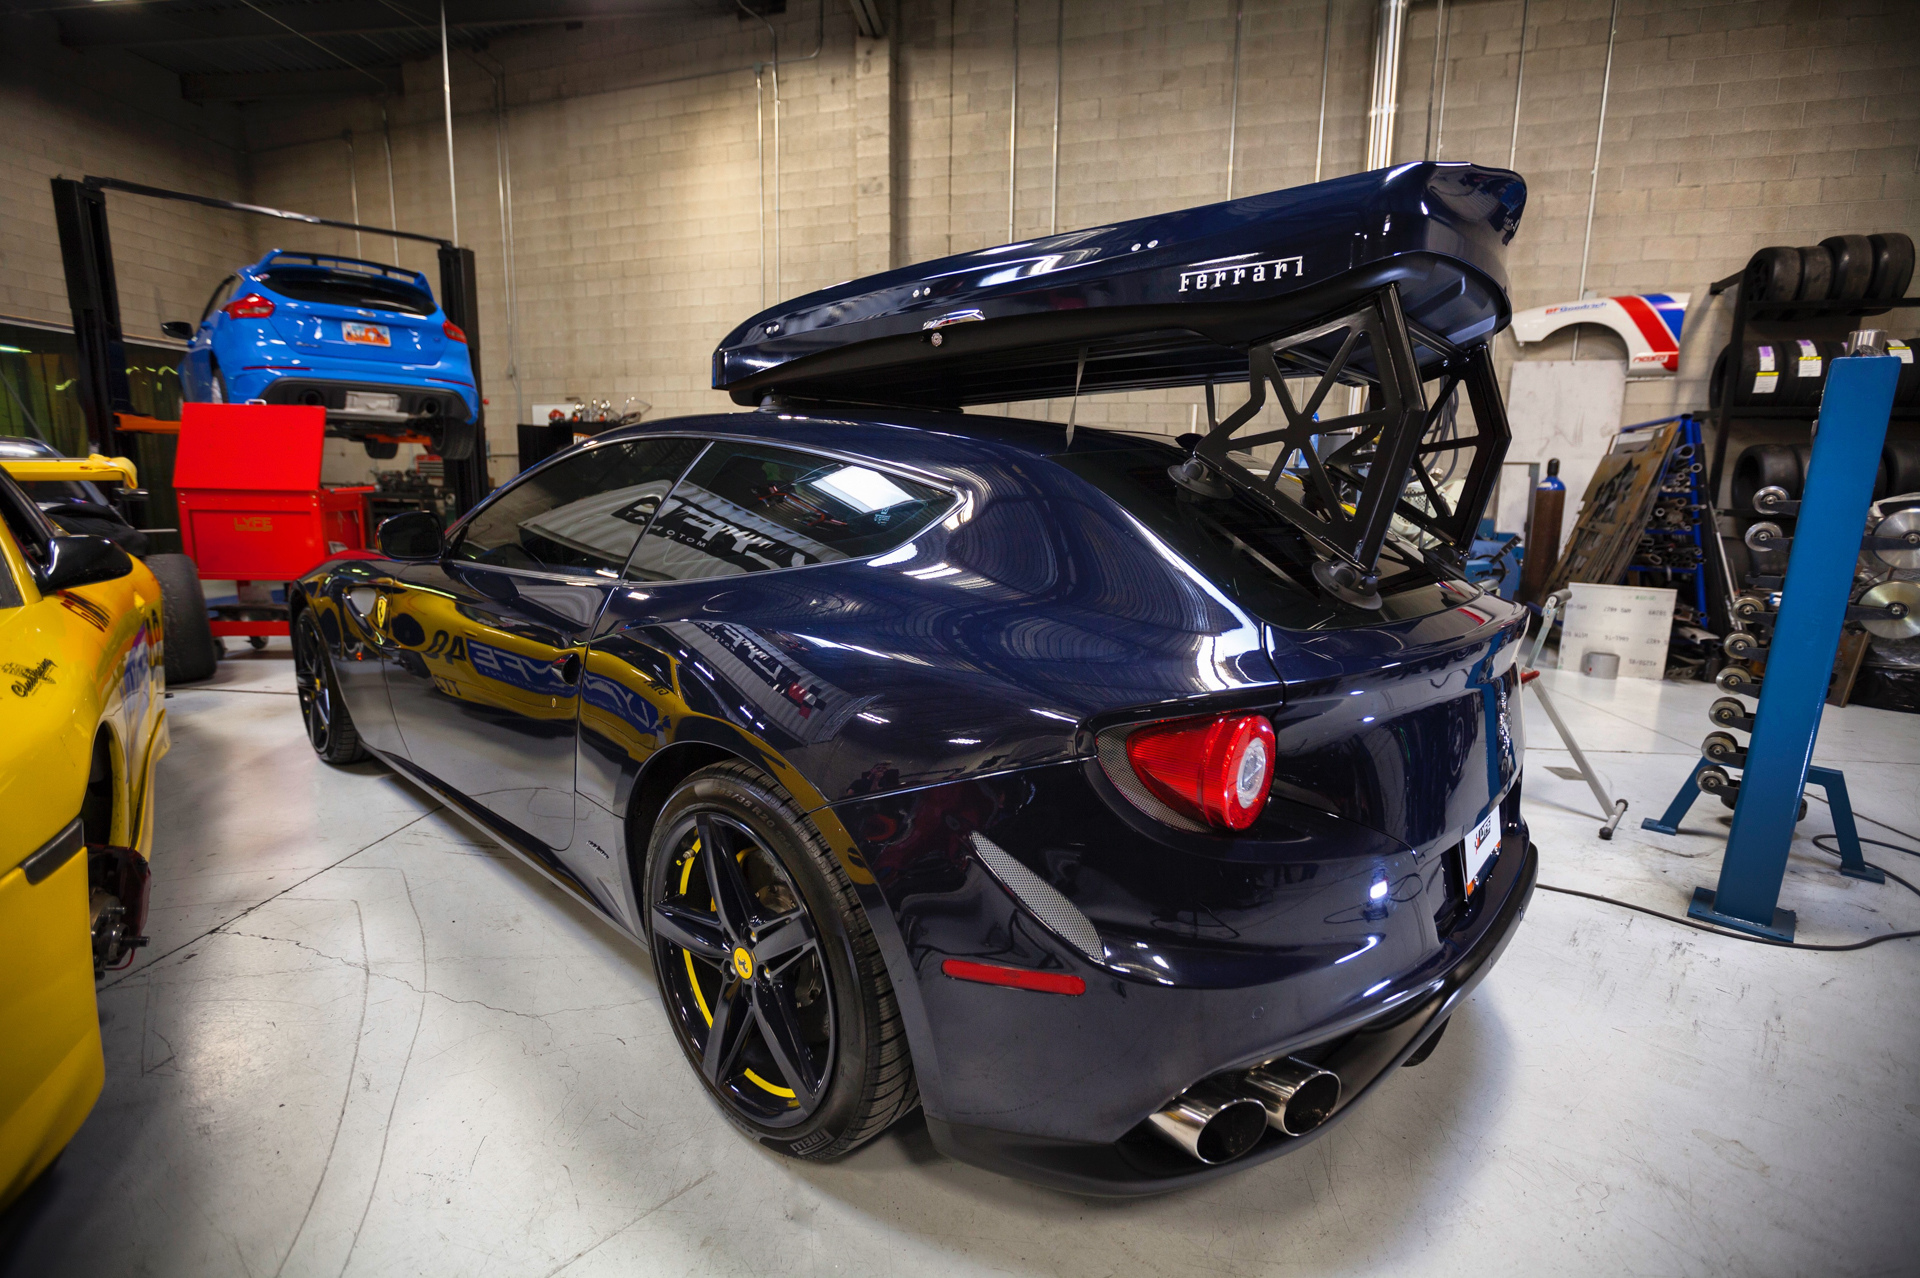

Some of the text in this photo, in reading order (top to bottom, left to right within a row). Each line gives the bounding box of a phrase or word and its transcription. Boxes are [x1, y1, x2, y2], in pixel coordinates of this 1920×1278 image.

[1178, 256, 1303, 293] Ferrari
[233, 516, 273, 532] LYFE
[789, 1127, 835, 1156] PIRELLI
